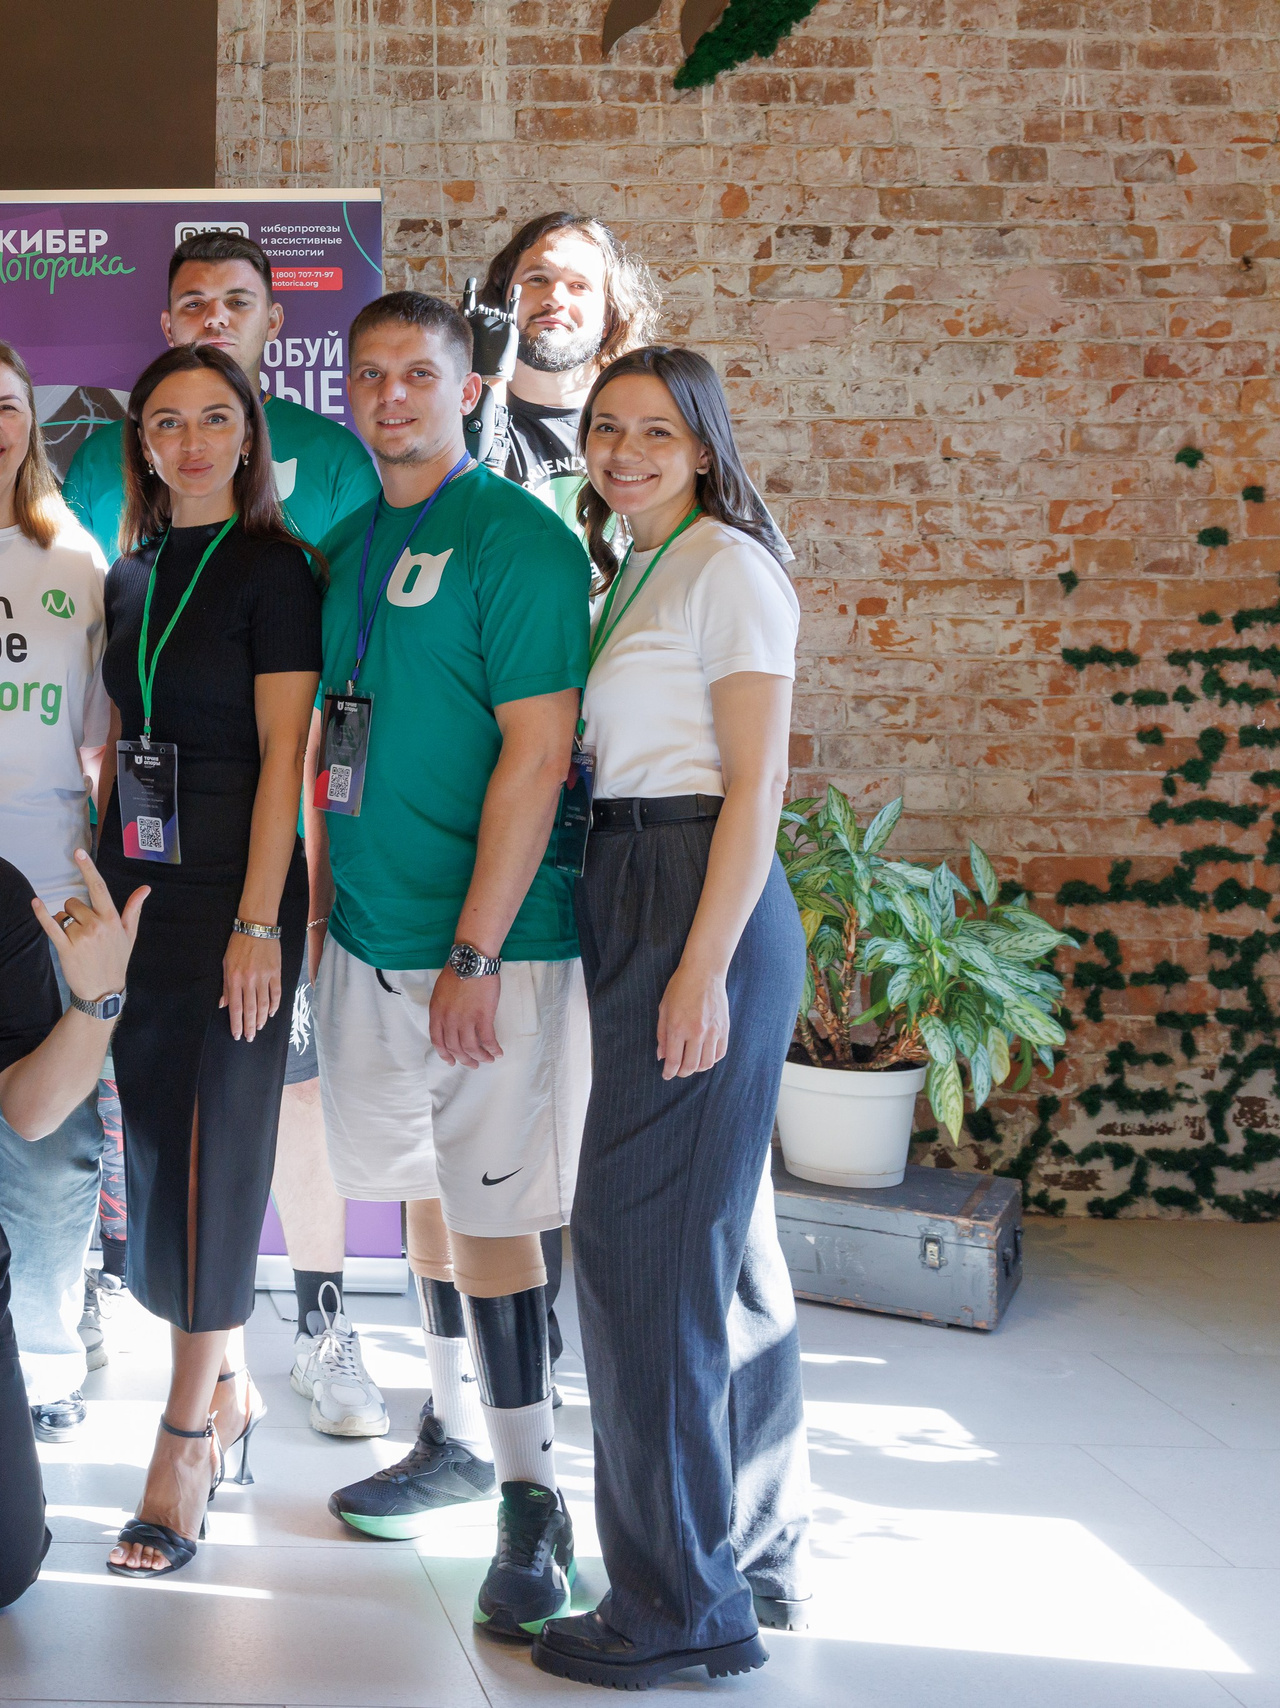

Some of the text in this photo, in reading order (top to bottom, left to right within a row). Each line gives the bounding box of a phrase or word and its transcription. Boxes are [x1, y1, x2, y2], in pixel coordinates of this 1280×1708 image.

[260, 223, 341, 234] киберпротезы
[261, 237, 343, 245] и ассистивные
[276, 271, 297, 279] (800)
[263, 330, 344, 368] ОБУЙ
